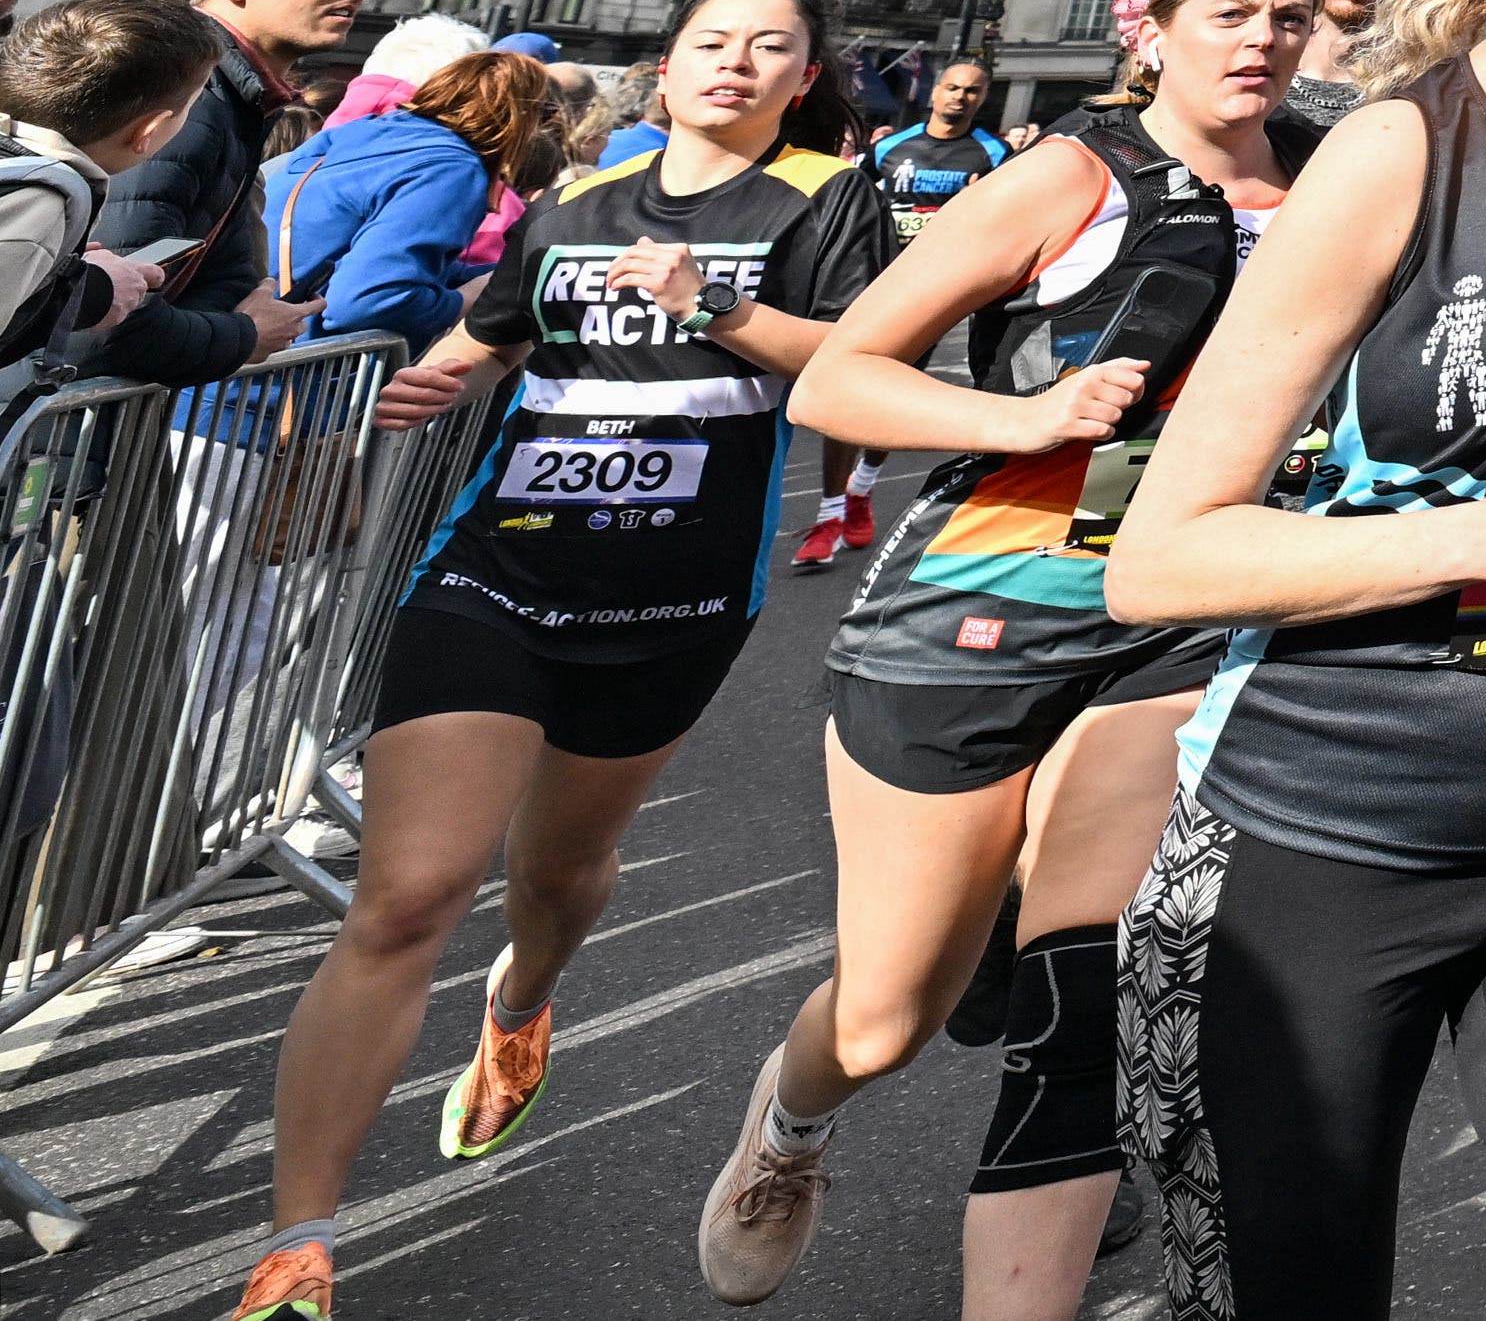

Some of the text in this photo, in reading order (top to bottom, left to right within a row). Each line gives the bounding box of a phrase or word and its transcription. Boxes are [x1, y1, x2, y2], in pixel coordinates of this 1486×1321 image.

[585, 420, 636, 435] BETH
[525, 450, 673, 494] 2309
[964, 619, 999, 634] FOR A
[960, 632, 997, 647] CURE
